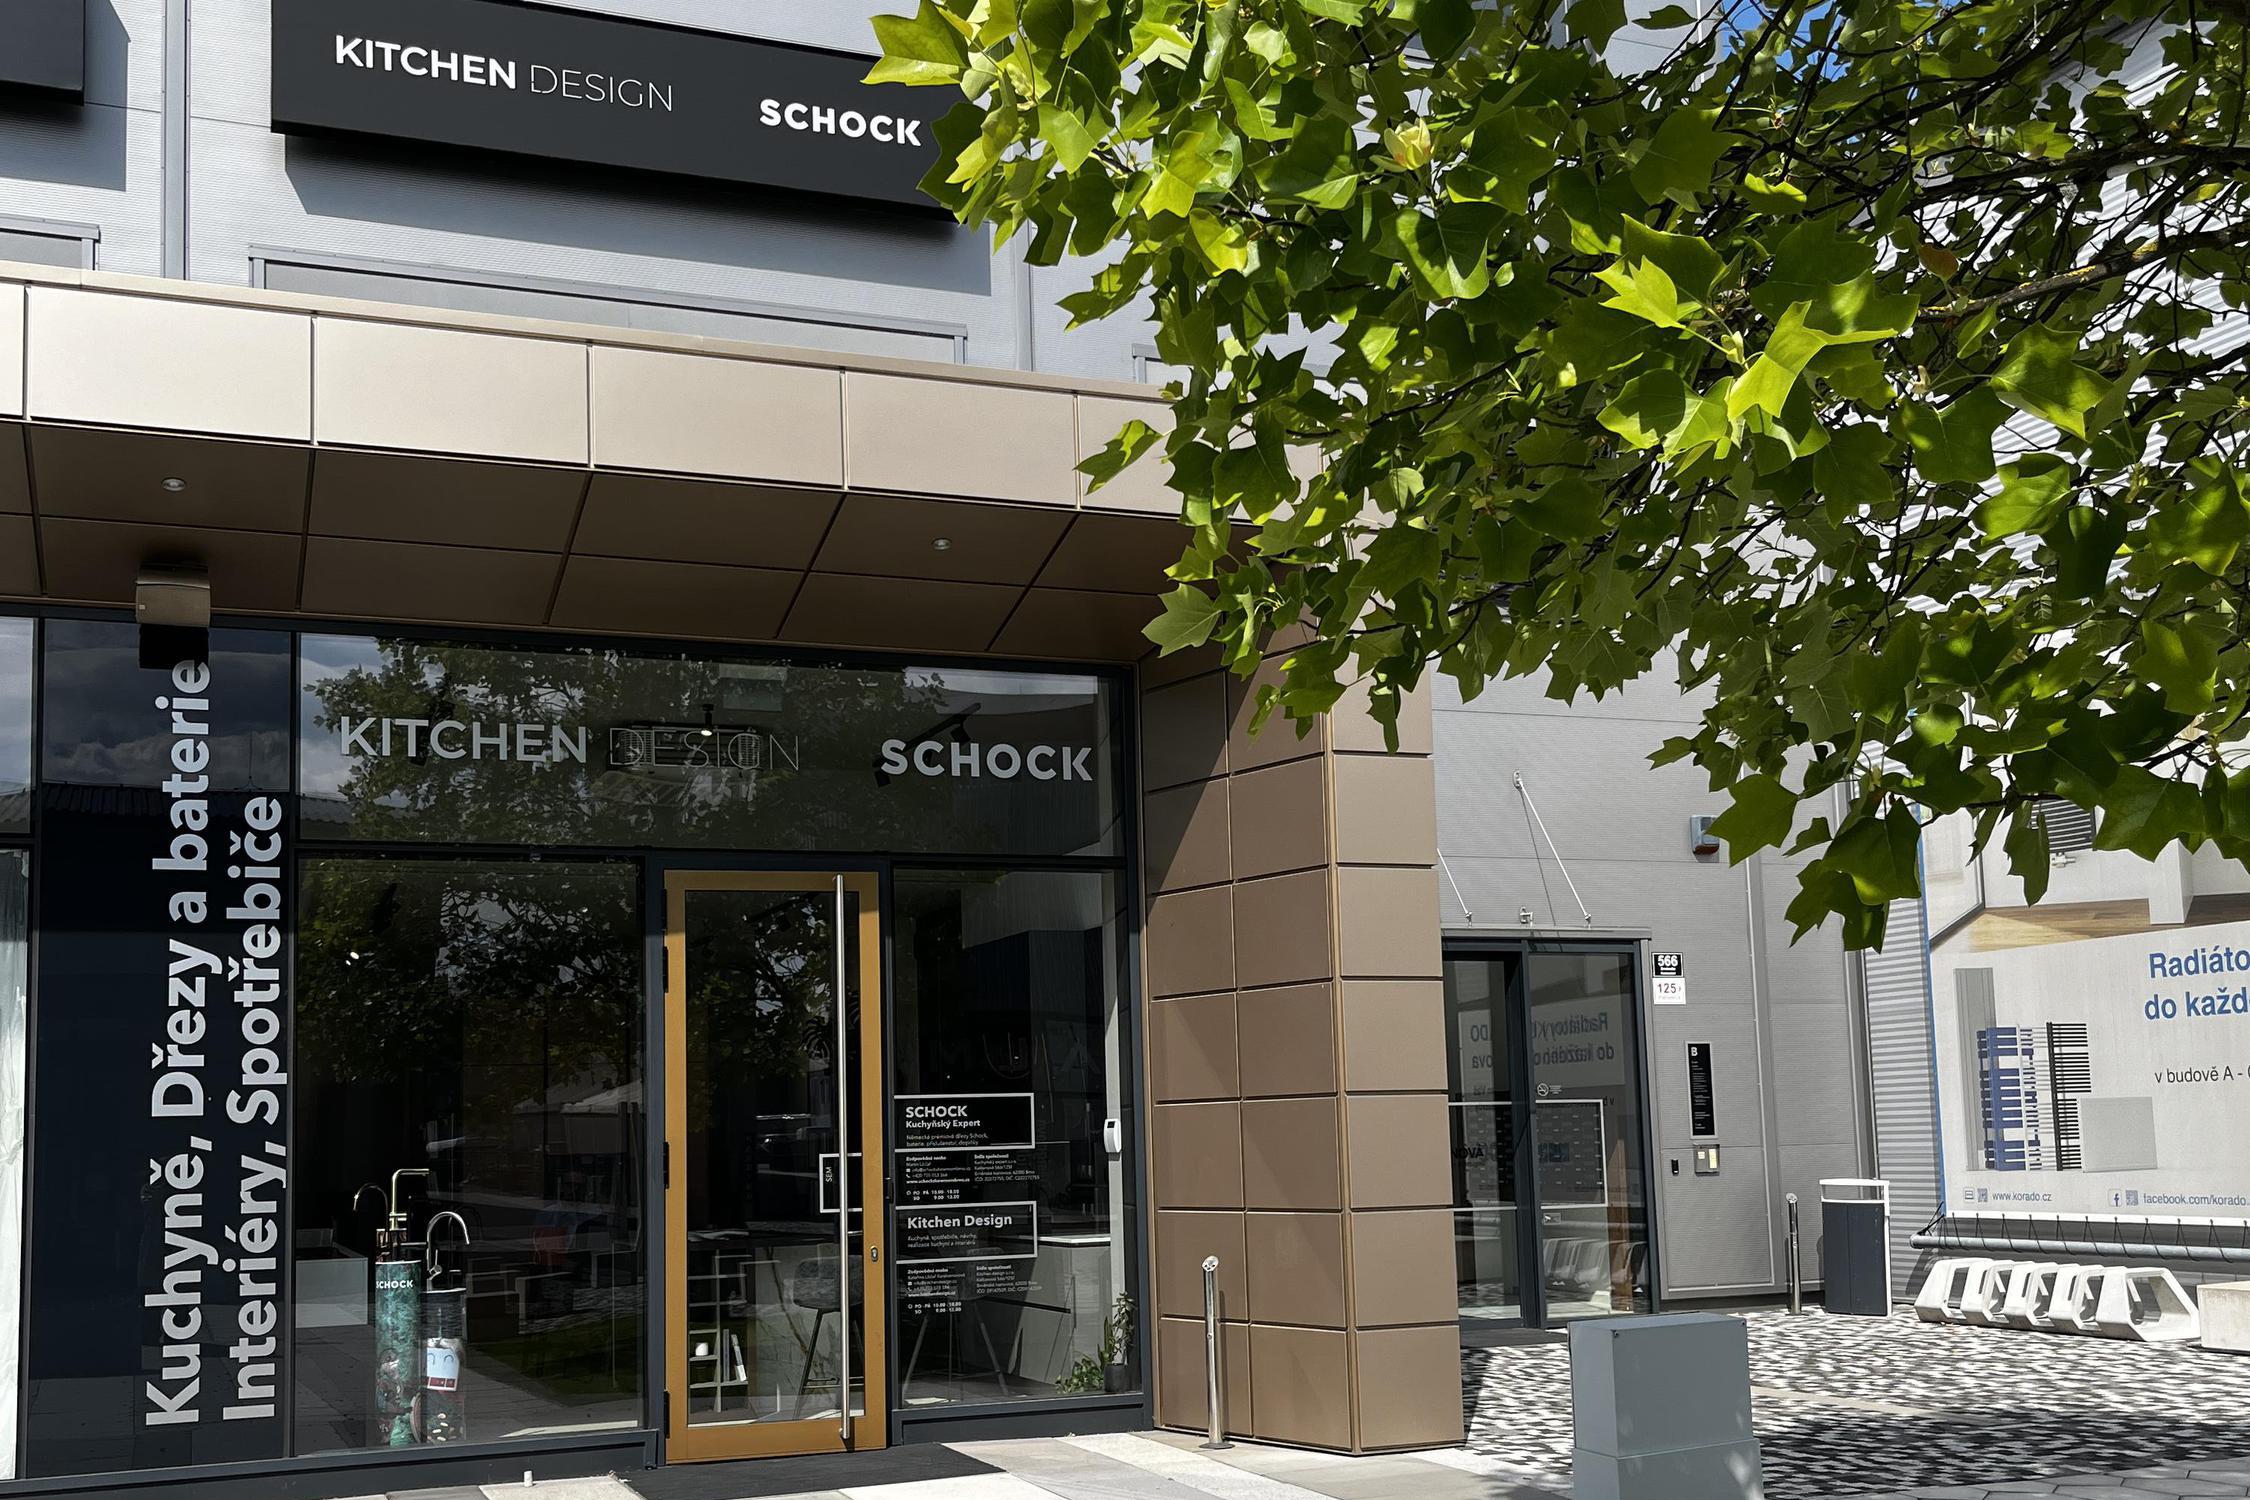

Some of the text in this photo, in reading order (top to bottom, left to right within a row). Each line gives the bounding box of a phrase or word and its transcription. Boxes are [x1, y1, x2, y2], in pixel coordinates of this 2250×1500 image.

[336, 34, 674, 112] KITCHEN DESIGN
[759, 98, 922, 147] SCHOCK
[340, 715, 799, 772] KITCHEN DESIGN
[881, 738, 1093, 783] SCHOCK
[1657, 954, 1678, 967] 566
[2144, 986, 2250, 1020] do každ
[145, 659, 223, 1426] Kuchyně, Dřezy a baterie
[1690, 1046, 1699, 1057] B
[2154, 1072, 2162, 1083] v
[2167, 1066, 2219, 1083] budově
[2223, 1065, 2234, 1081] A
[222, 796, 288, 1421] Interiéry, Spotřebiče
[905, 1105, 968, 1118] SCHOCK
[905, 1119, 981, 1130] Kuchyňský Expert
[1992, 1191, 2052, 1203] www.korado.cz
[907, 1213, 1013, 1229] Kitchen Design
[375, 1279, 414, 1290] SCHOCK
